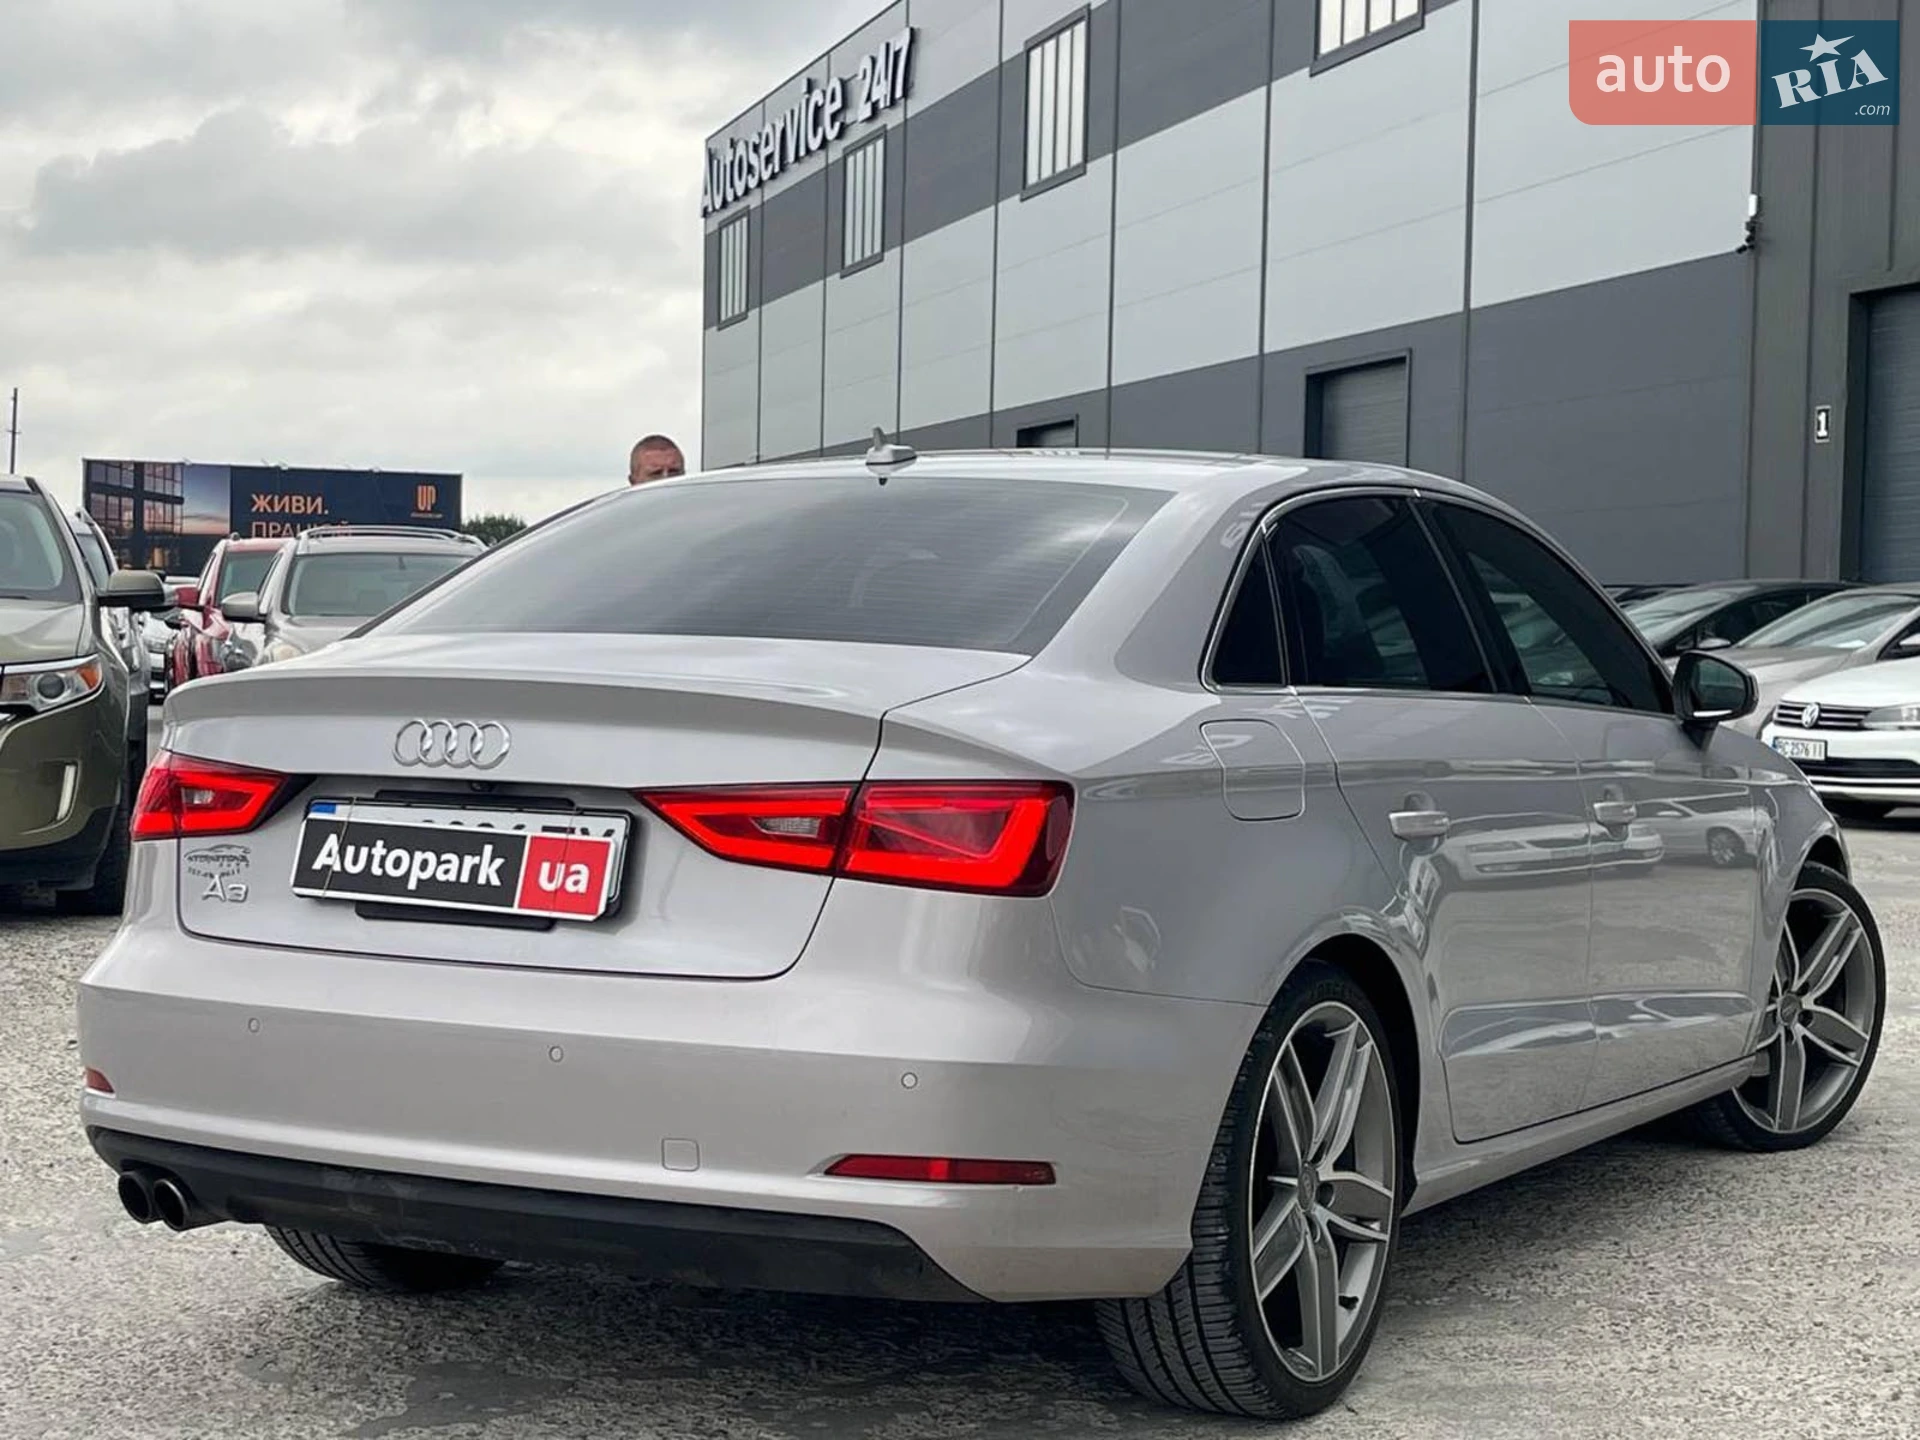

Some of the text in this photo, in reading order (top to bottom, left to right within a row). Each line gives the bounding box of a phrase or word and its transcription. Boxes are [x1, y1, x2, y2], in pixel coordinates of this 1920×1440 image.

[701, 27, 914, 215] Autoservice 24/7
[1817, 411, 1828, 437] 1
[251, 494, 329, 515] ЖИВИ.
[417, 485, 436, 511] UP
[312, 833, 591, 894] Autopark ua
[202, 875, 249, 902] A3
